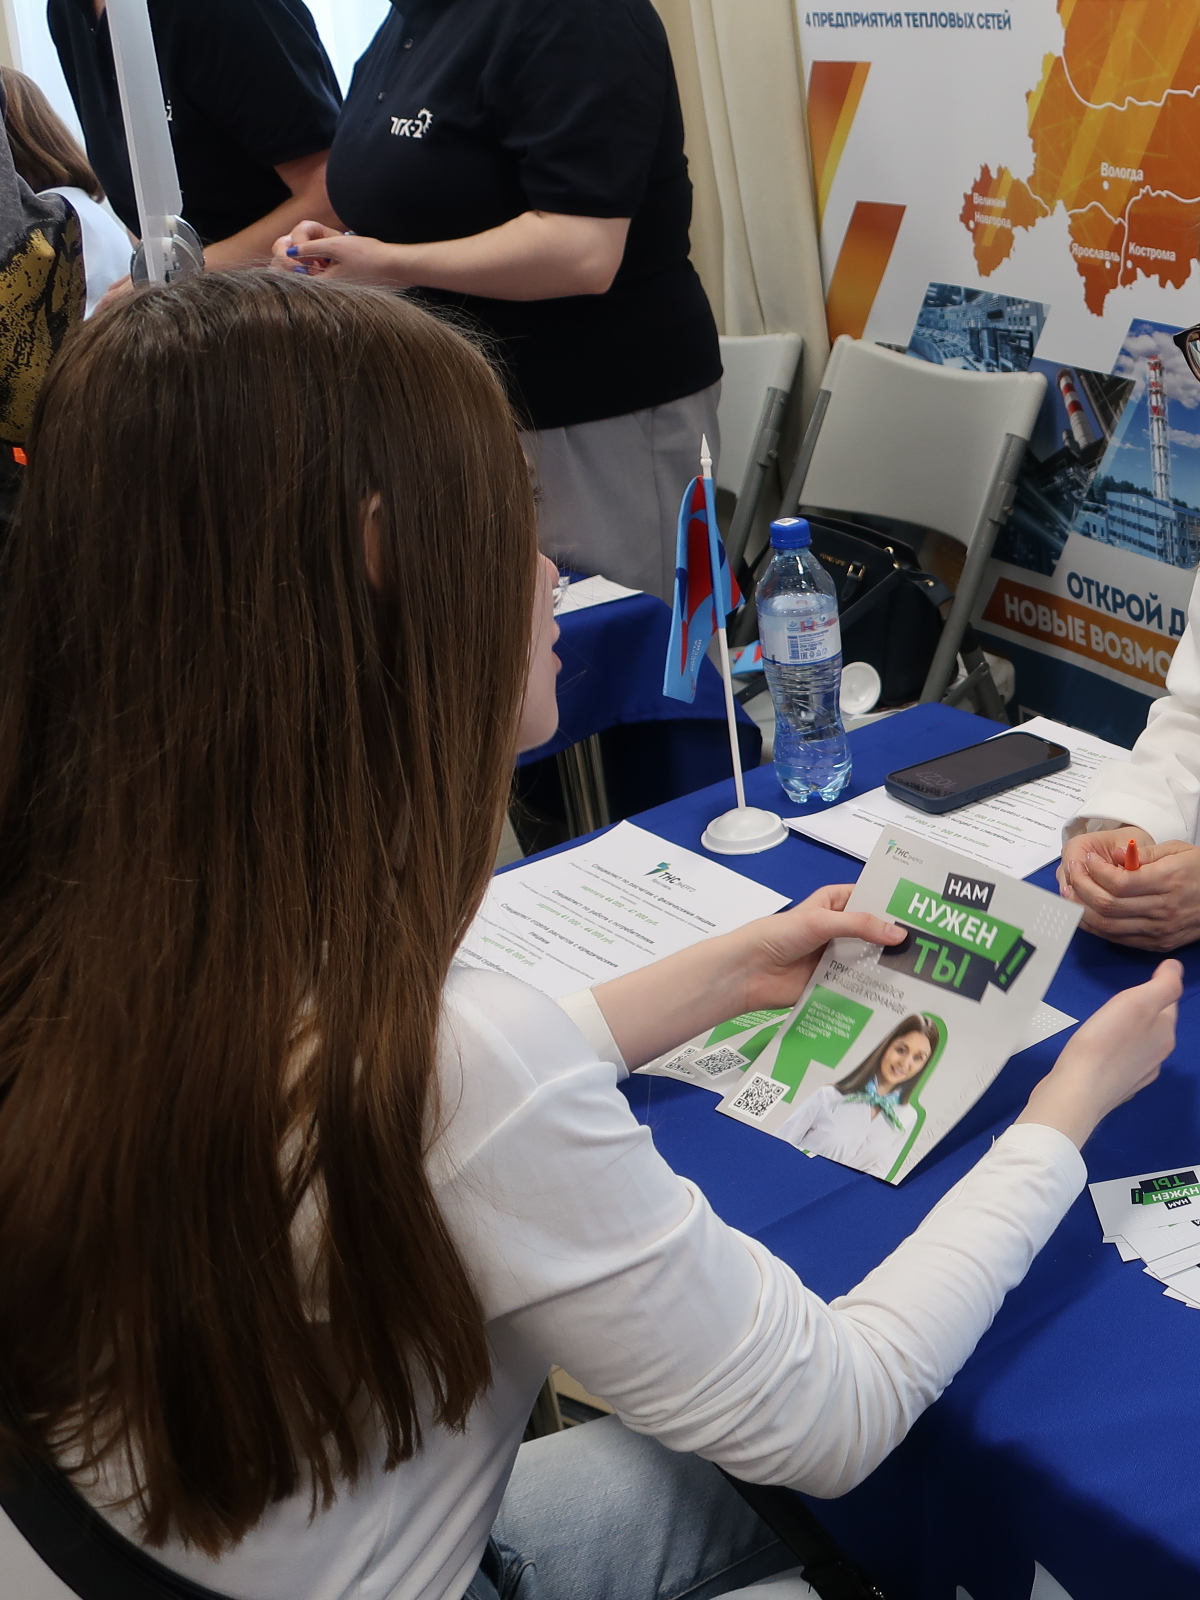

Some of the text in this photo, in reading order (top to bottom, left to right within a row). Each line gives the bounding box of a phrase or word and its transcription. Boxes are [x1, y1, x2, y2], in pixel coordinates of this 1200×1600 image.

[812, 12, 902, 29] ПРЕДПРИЯТИЯ
[904, 12, 976, 29] ТЕПЛОВЫХ
[976, 9, 1012, 30] СЕТЕЙ
[1100, 162, 1144, 182] Вологда
[1071, 243, 1120, 263] Ярославль
[1128, 242, 1176, 262] Кострома
[1066, 571, 1164, 630] ОТКРОЙ
[1004, 593, 1088, 646] НОВЫЕ
[894, 847, 910, 859] ТНС
[658, 871, 680, 883] ТНС
[591, 863, 622, 879] Специалист
[627, 882, 654, 896] расчетам
[657, 897, 694, 916] физическими
[693, 915, 716, 927] лицами
[948, 878, 990, 904] НАМ
[580, 885, 604, 898] зарплата
[611, 900, 624, 908] 000
[634, 912, 648, 920] 000
[551, 889, 583, 906] Специалист
[587, 909, 608, 921] работе
[612, 921, 654, 944] потребителями
[907, 892, 998, 950] НУЖЕН
[500, 903, 531, 920] Специалист
[529, 919, 550, 930] отдела
[546, 929, 574, 944] расчетов
[577, 945, 618, 967] юридическими
[528, 931, 550, 944] лицами
[913, 936, 1028, 989] ТЫ !
[1152, 1175, 1186, 1190] ТЫ
[1152, 1186, 1200, 1202] НУЖЕН
[1167, 1198, 1189, 1209] НАМ
